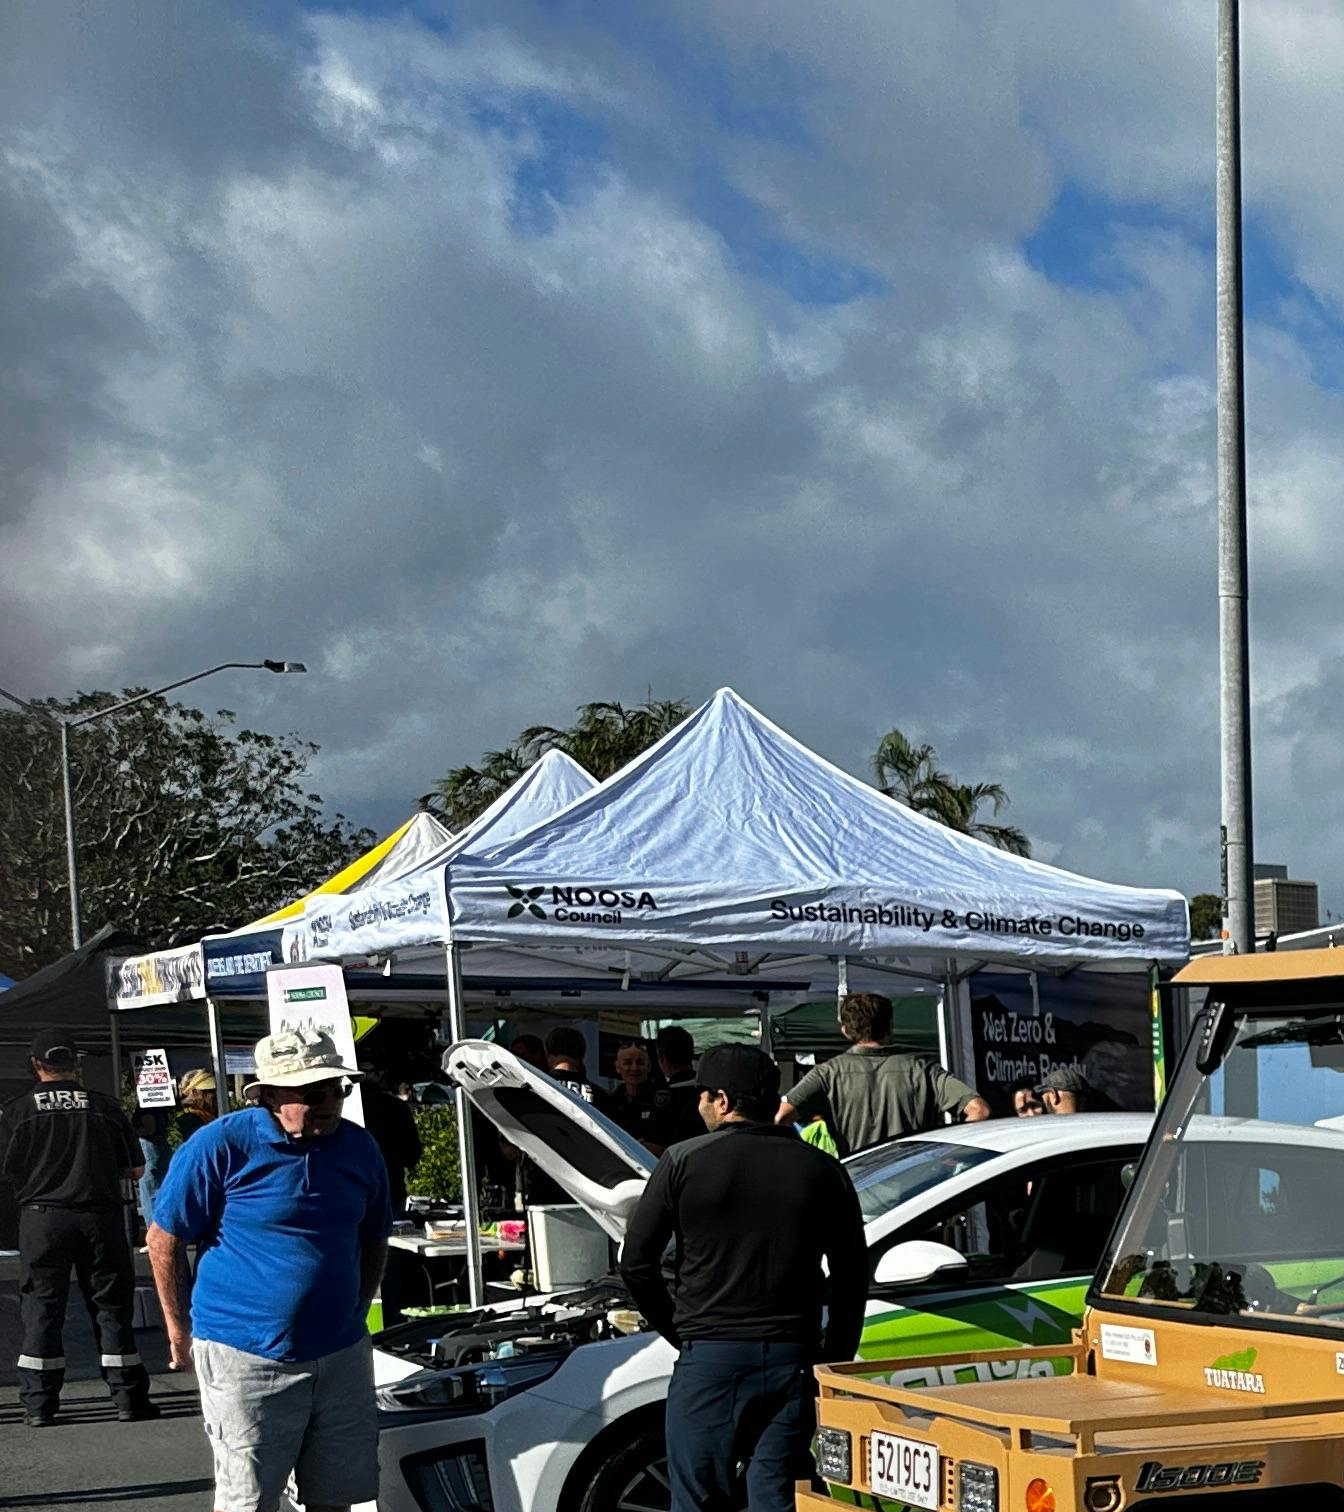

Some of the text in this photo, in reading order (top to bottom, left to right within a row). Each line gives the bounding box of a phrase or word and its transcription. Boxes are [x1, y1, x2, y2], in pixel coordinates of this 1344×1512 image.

[552, 885, 657, 910] NOOSA
[554, 907, 622, 924] Council
[770, 900, 1144, 942] Sustainability & Climate Change
[982, 1012, 1056, 1044] Net Zero &
[985, 1051, 1037, 1082] Climate
[34, 1090, 88, 1104] FIRE
[37, 1101, 90, 1110] RESCUE
[1203, 1367, 1265, 1393] TUATARA
[877, 1438, 932, 1493] 5219C3
